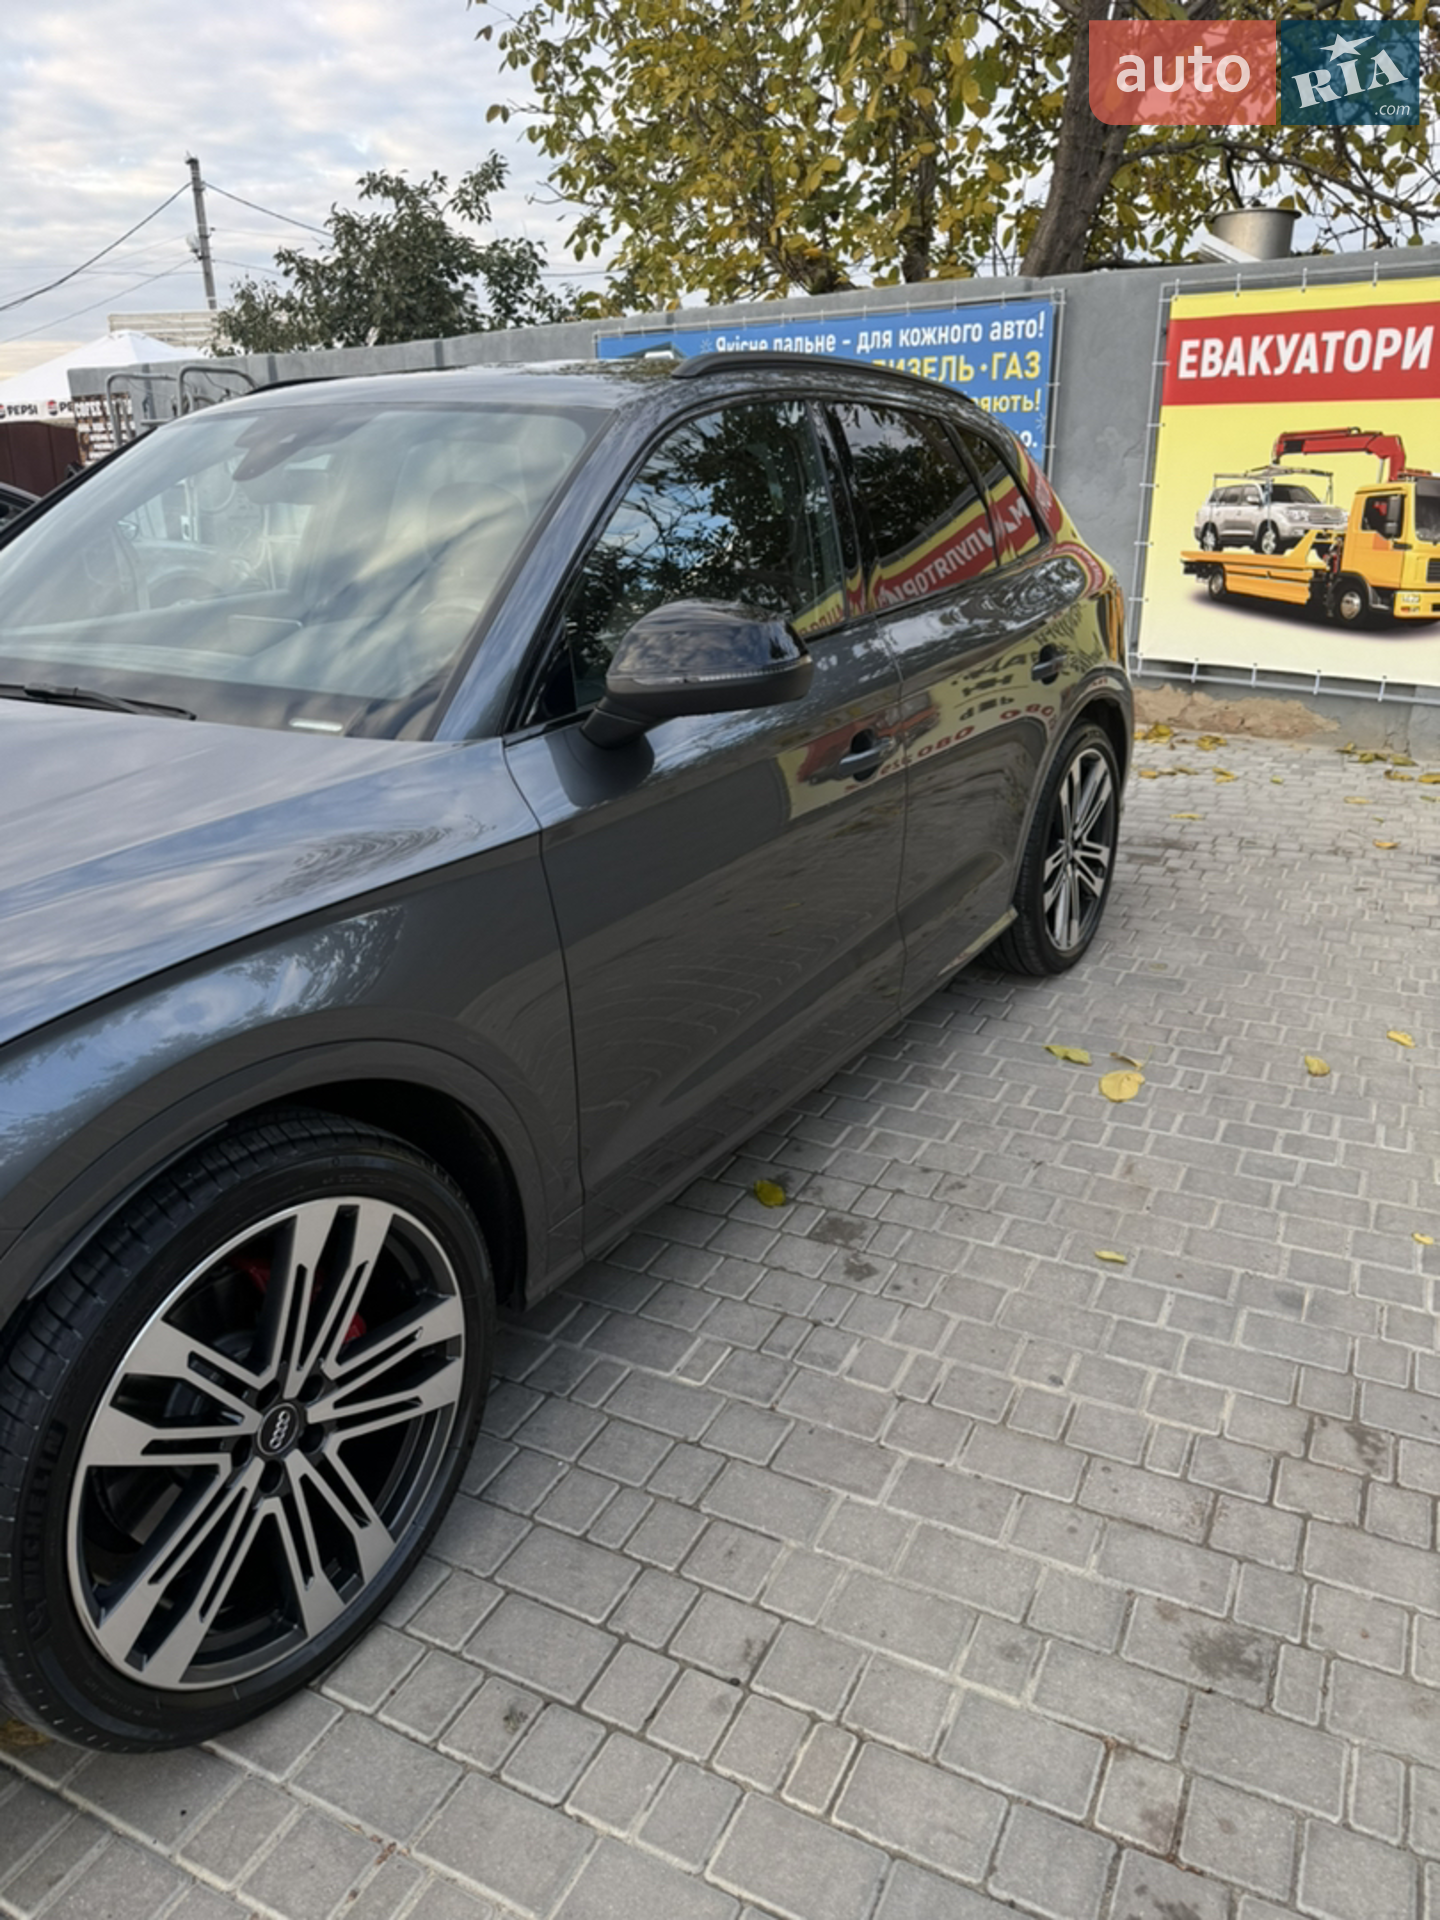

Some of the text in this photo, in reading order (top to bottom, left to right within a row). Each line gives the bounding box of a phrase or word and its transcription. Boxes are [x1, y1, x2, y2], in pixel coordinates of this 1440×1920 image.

[772, 333, 836, 353] пальне
[856, 329, 893, 354] для
[899, 322, 983, 348] кожного
[989, 310, 1046, 342] авто!
[872, 350, 1042, 382] ЗЕЛЬ ГАЗ
[1177, 325, 1435, 380] ЕВАКУАТОРИ
[7, 403, 38, 416] PEPSI
[968, 387, 1041, 413] яють!
